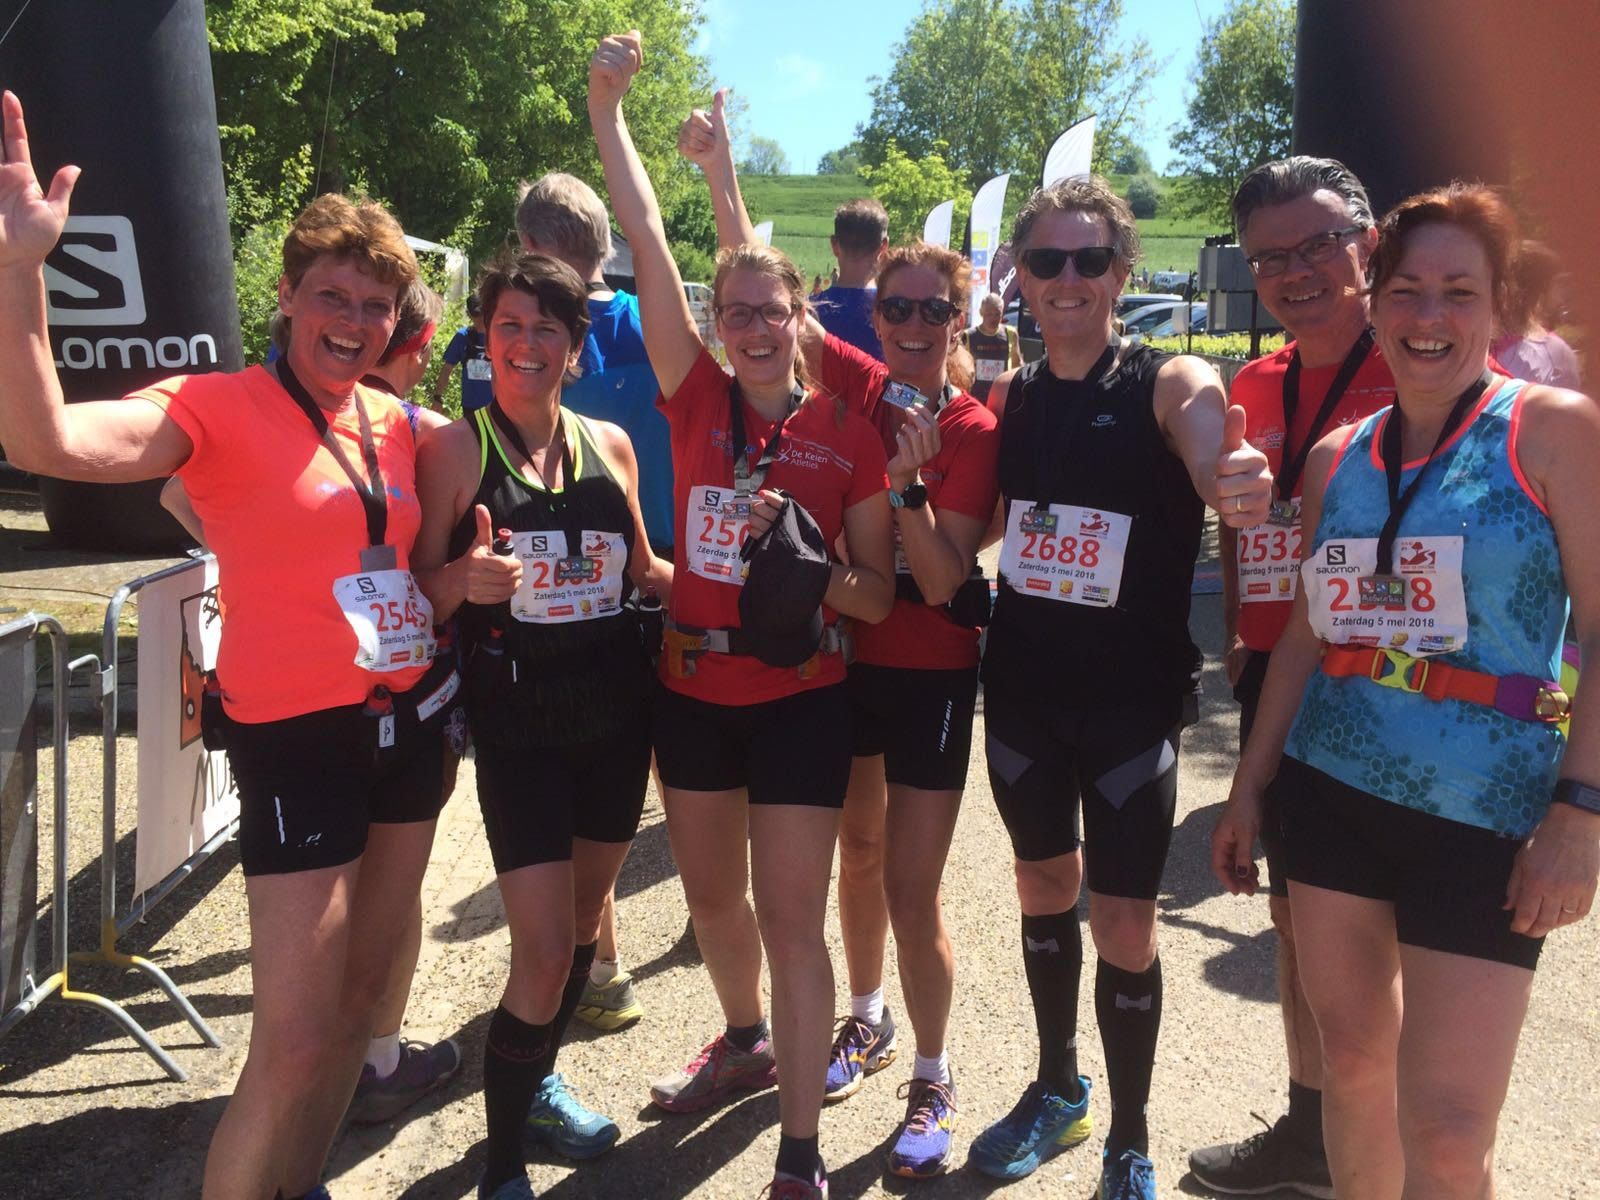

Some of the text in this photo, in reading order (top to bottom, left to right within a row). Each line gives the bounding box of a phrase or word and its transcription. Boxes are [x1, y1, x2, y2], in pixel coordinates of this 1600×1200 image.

[1020, 531, 1101, 568] 2688
[1240, 528, 1302, 564] 2532
[1018, 561, 1050, 574] Zaterdag
[1057, 567, 1073, 576] mei
[1075, 570, 1096, 580] 2018
[533, 591, 566, 600] Zaterdag
[587, 586, 605, 595] 2018
[370, 600, 427, 632] 2545
[1332, 617, 1435, 628] Zaterdag 5 mei 2018
